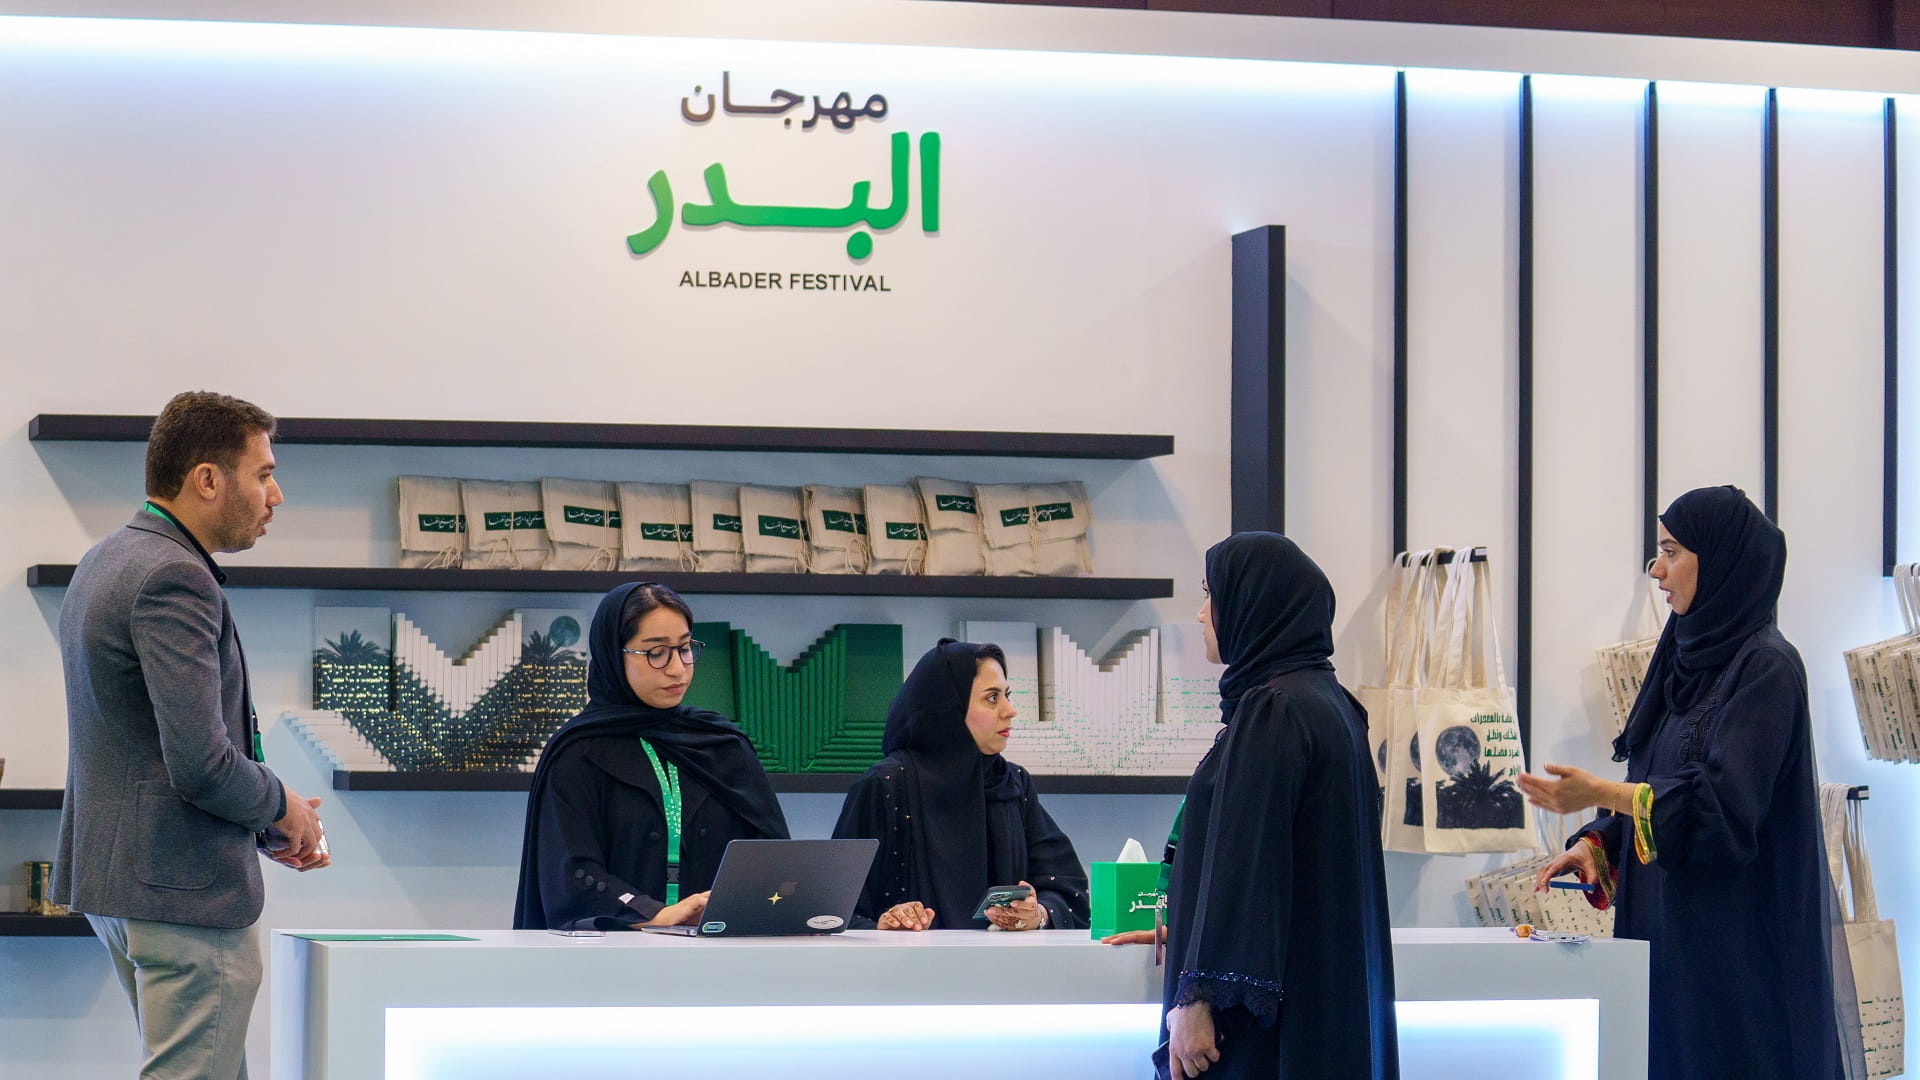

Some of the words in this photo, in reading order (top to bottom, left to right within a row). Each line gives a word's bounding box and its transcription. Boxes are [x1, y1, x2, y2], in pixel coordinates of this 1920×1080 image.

[681, 71, 888, 129] مهرجان
[626, 131, 941, 260] البدر
[679, 271, 782, 290] ALBADER
[790, 273, 891, 292] FESTIVAL
